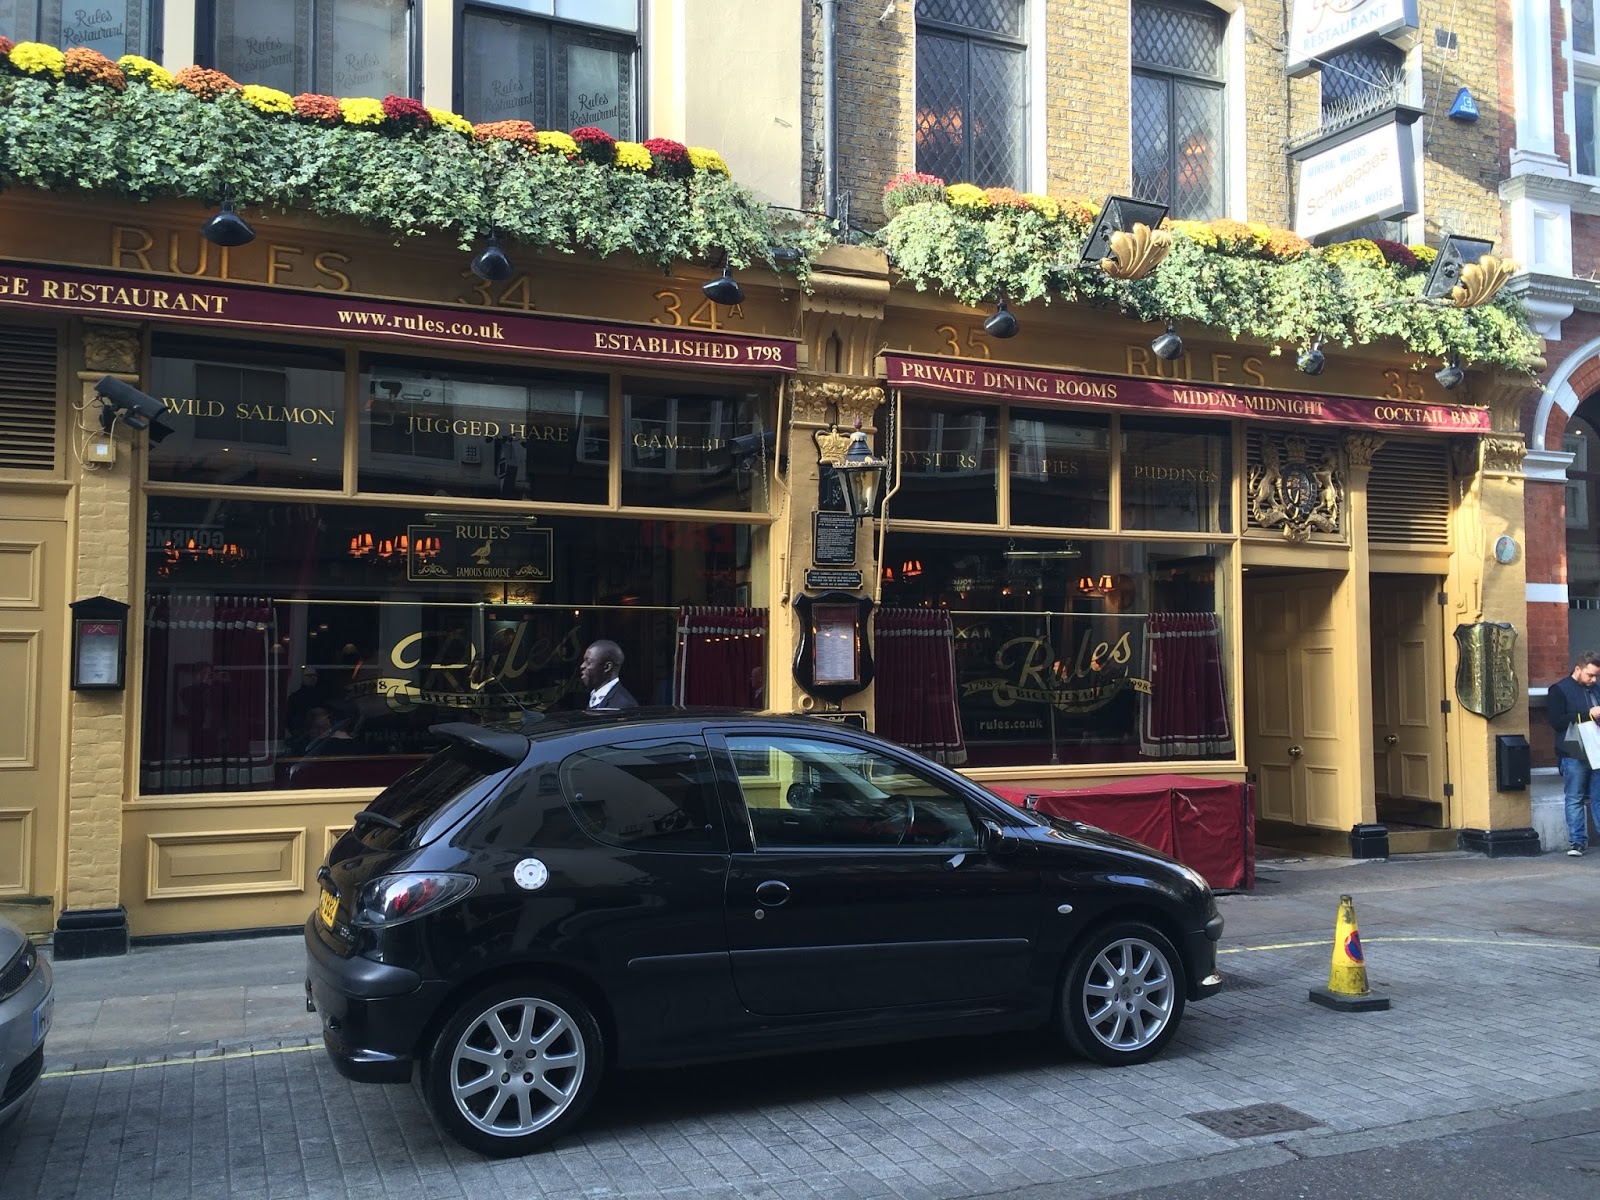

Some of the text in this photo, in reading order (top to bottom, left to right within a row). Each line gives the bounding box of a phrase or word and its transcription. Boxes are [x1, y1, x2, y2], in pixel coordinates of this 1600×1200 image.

[75, 9, 113, 27] Rules
[1303, 4, 1387, 50] RESTAURANT
[64, 22, 124, 45] Restaurant
[246, 36, 282, 54] Rules
[235, 51, 293, 73] Restaurant
[344, 52, 380, 71] Rules
[491, 78, 524, 97] Rules
[484, 92, 534, 113] Restaurant
[578, 92, 609, 111] Rules
[570, 105, 618, 127] Restaurant
[111, 224, 352, 293] RULES
[41, 279, 228, 314] RESTAURANT
[457, 267, 536, 310] 34
[337, 310, 505, 340] www.rules.co.uk
[594, 332, 783, 362] ESTABLISHED 1798
[935, 324, 992, 359] 35
[1126, 343, 1266, 389] RULES
[900, 361, 1118, 399] PRIVATE DINING ROOMS
[1382, 367, 1425, 400] 35
[161, 397, 336, 426] WILD SALMON
[1173, 389, 1325, 416] MIDDAY-MIDNIGHT
[1374, 405, 1481, 426] COCKTAIL BAR
[405, 416, 569, 443] JUGGED HARE
[633, 432, 694, 450] GAME
[1042, 459, 1078, 475] PIES
[1133, 465, 1220, 484] PUDDINGS
[456, 525, 510, 539] RULE'S
[456, 567, 510, 577] FAMOUS GROUSE
[390, 621, 582, 693] Rules
[994, 629, 1132, 690] Rules
[967, 680, 994, 691] 1798
[979, 718, 1043, 730] rules.co.uk
